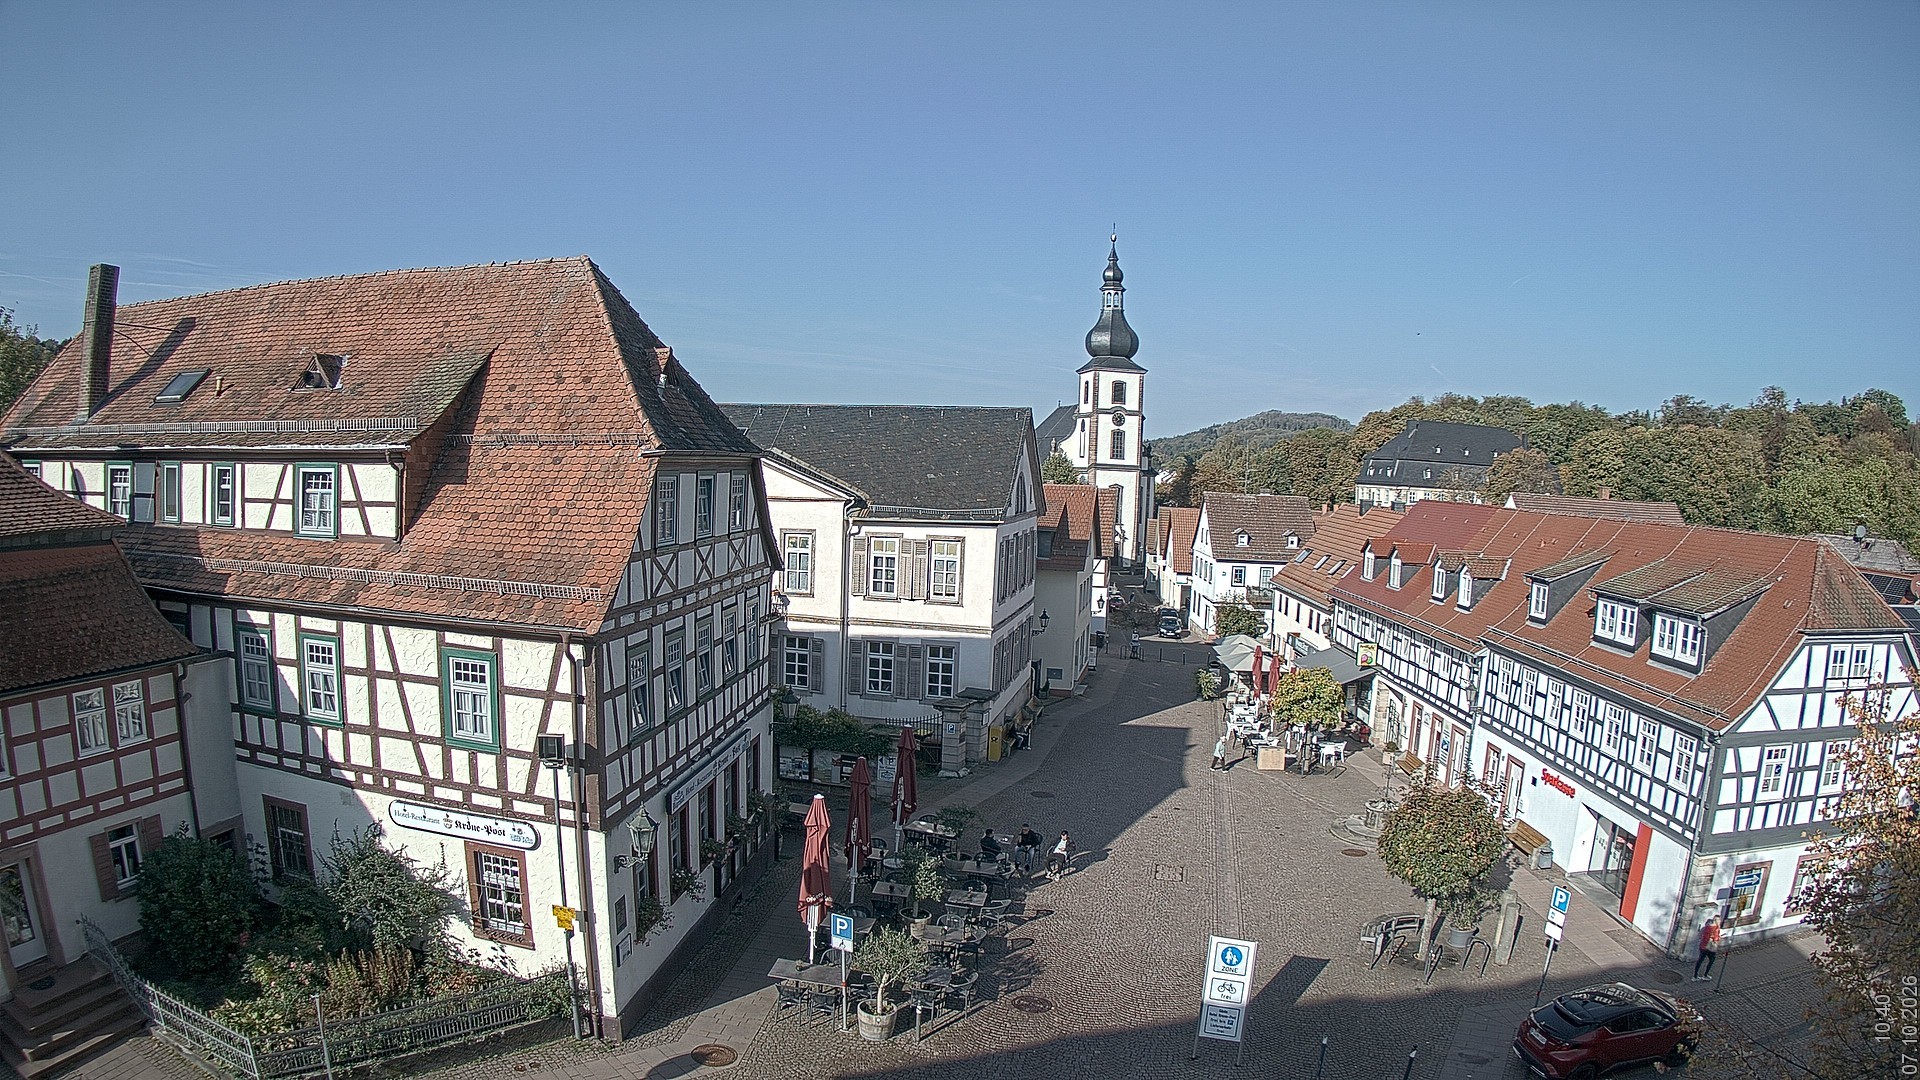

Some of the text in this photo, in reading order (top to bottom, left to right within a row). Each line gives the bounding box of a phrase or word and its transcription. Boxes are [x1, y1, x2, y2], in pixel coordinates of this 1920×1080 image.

[1541, 768, 1576, 798] Sparkasse
[394, 809, 506, 837] Hotel-Restaurant Krone-Post
[1554, 890, 1567, 908] P
[836, 918, 848, 935] P
[1221, 965, 1239, 973] ZONE
